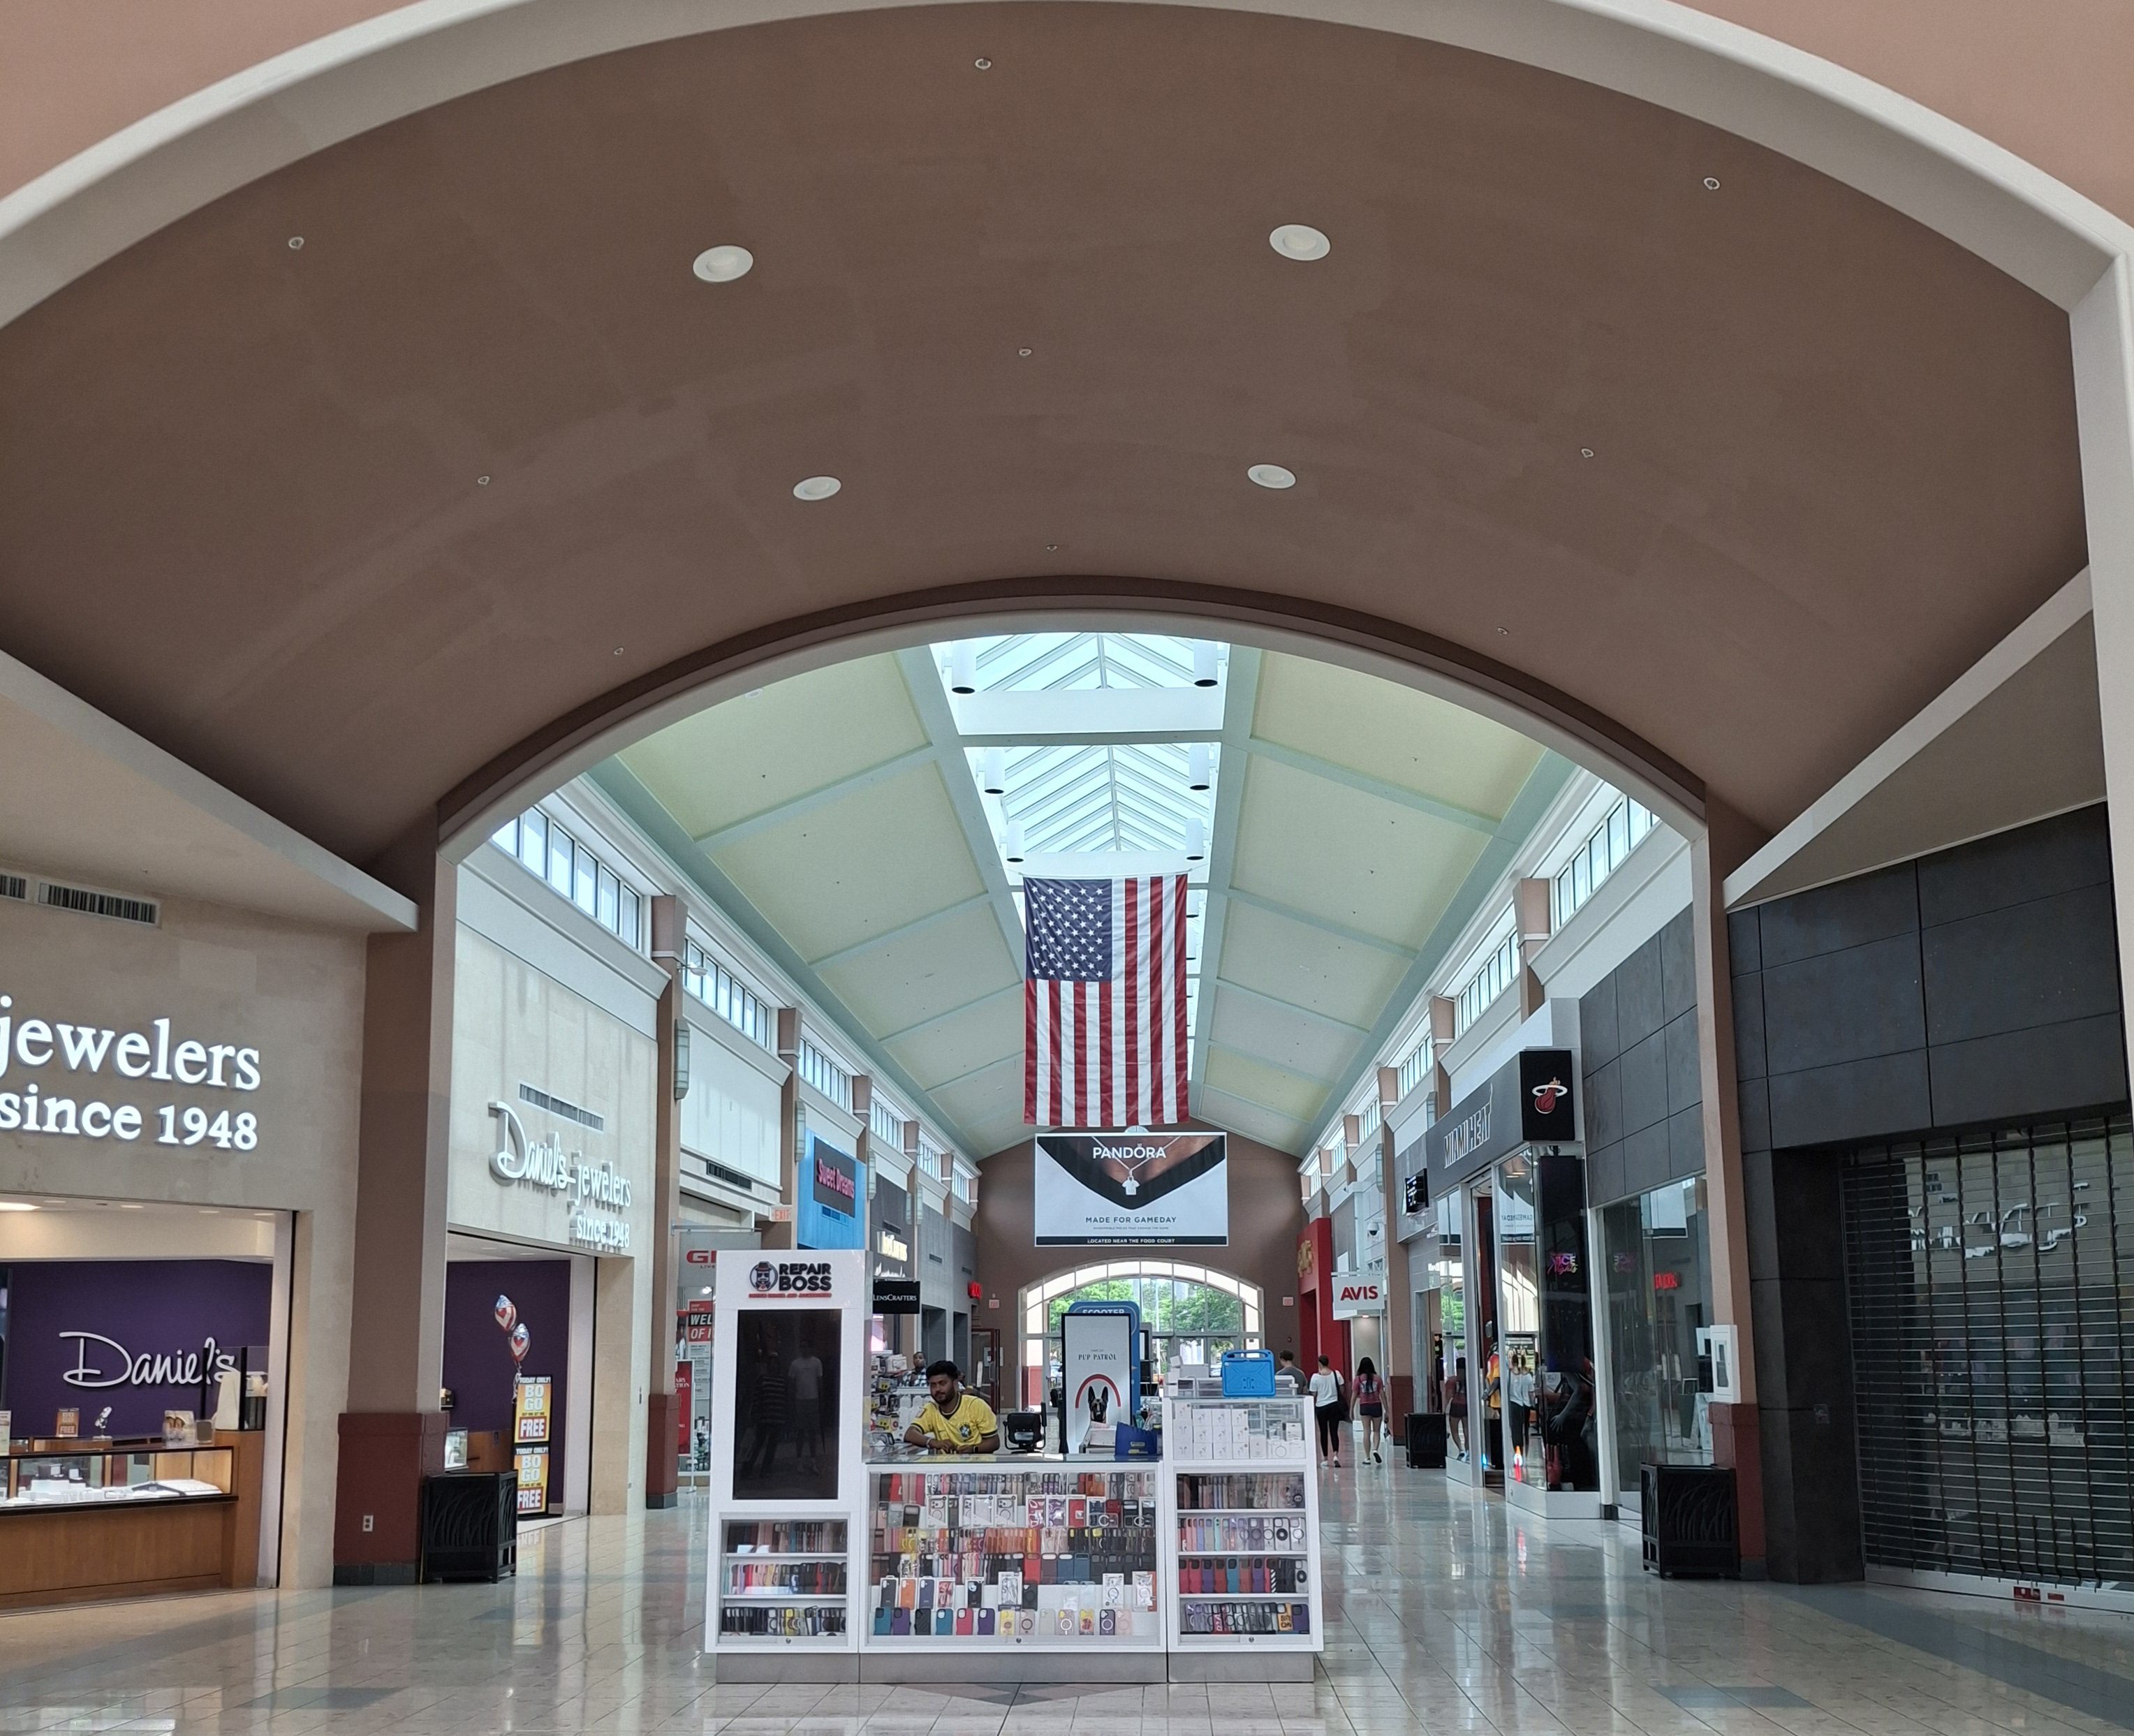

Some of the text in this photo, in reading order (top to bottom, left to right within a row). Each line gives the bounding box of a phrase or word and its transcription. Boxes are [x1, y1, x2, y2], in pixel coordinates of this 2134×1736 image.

[0, 995, 260, 1091] jewelers
[0, 1084, 258, 1151] since 1948
[1443, 1083, 1493, 1169] MIAMI HEAT
[1092, 1145, 1167, 1159] PANDORA
[574, 1149, 631, 1207] jewelers
[576, 1209, 630, 1248] since 1948
[779, 1263, 832, 1275] REPAIR
[778, 1275, 832, 1291] BOSS
[1340, 1285, 1378, 1301] AVIS
[690, 1327, 705, 1339] OF
[59, 1331, 268, 1387] Daniel's
[520, 1418, 545, 1438] FREE
[517, 1488, 542, 1509] FREE
